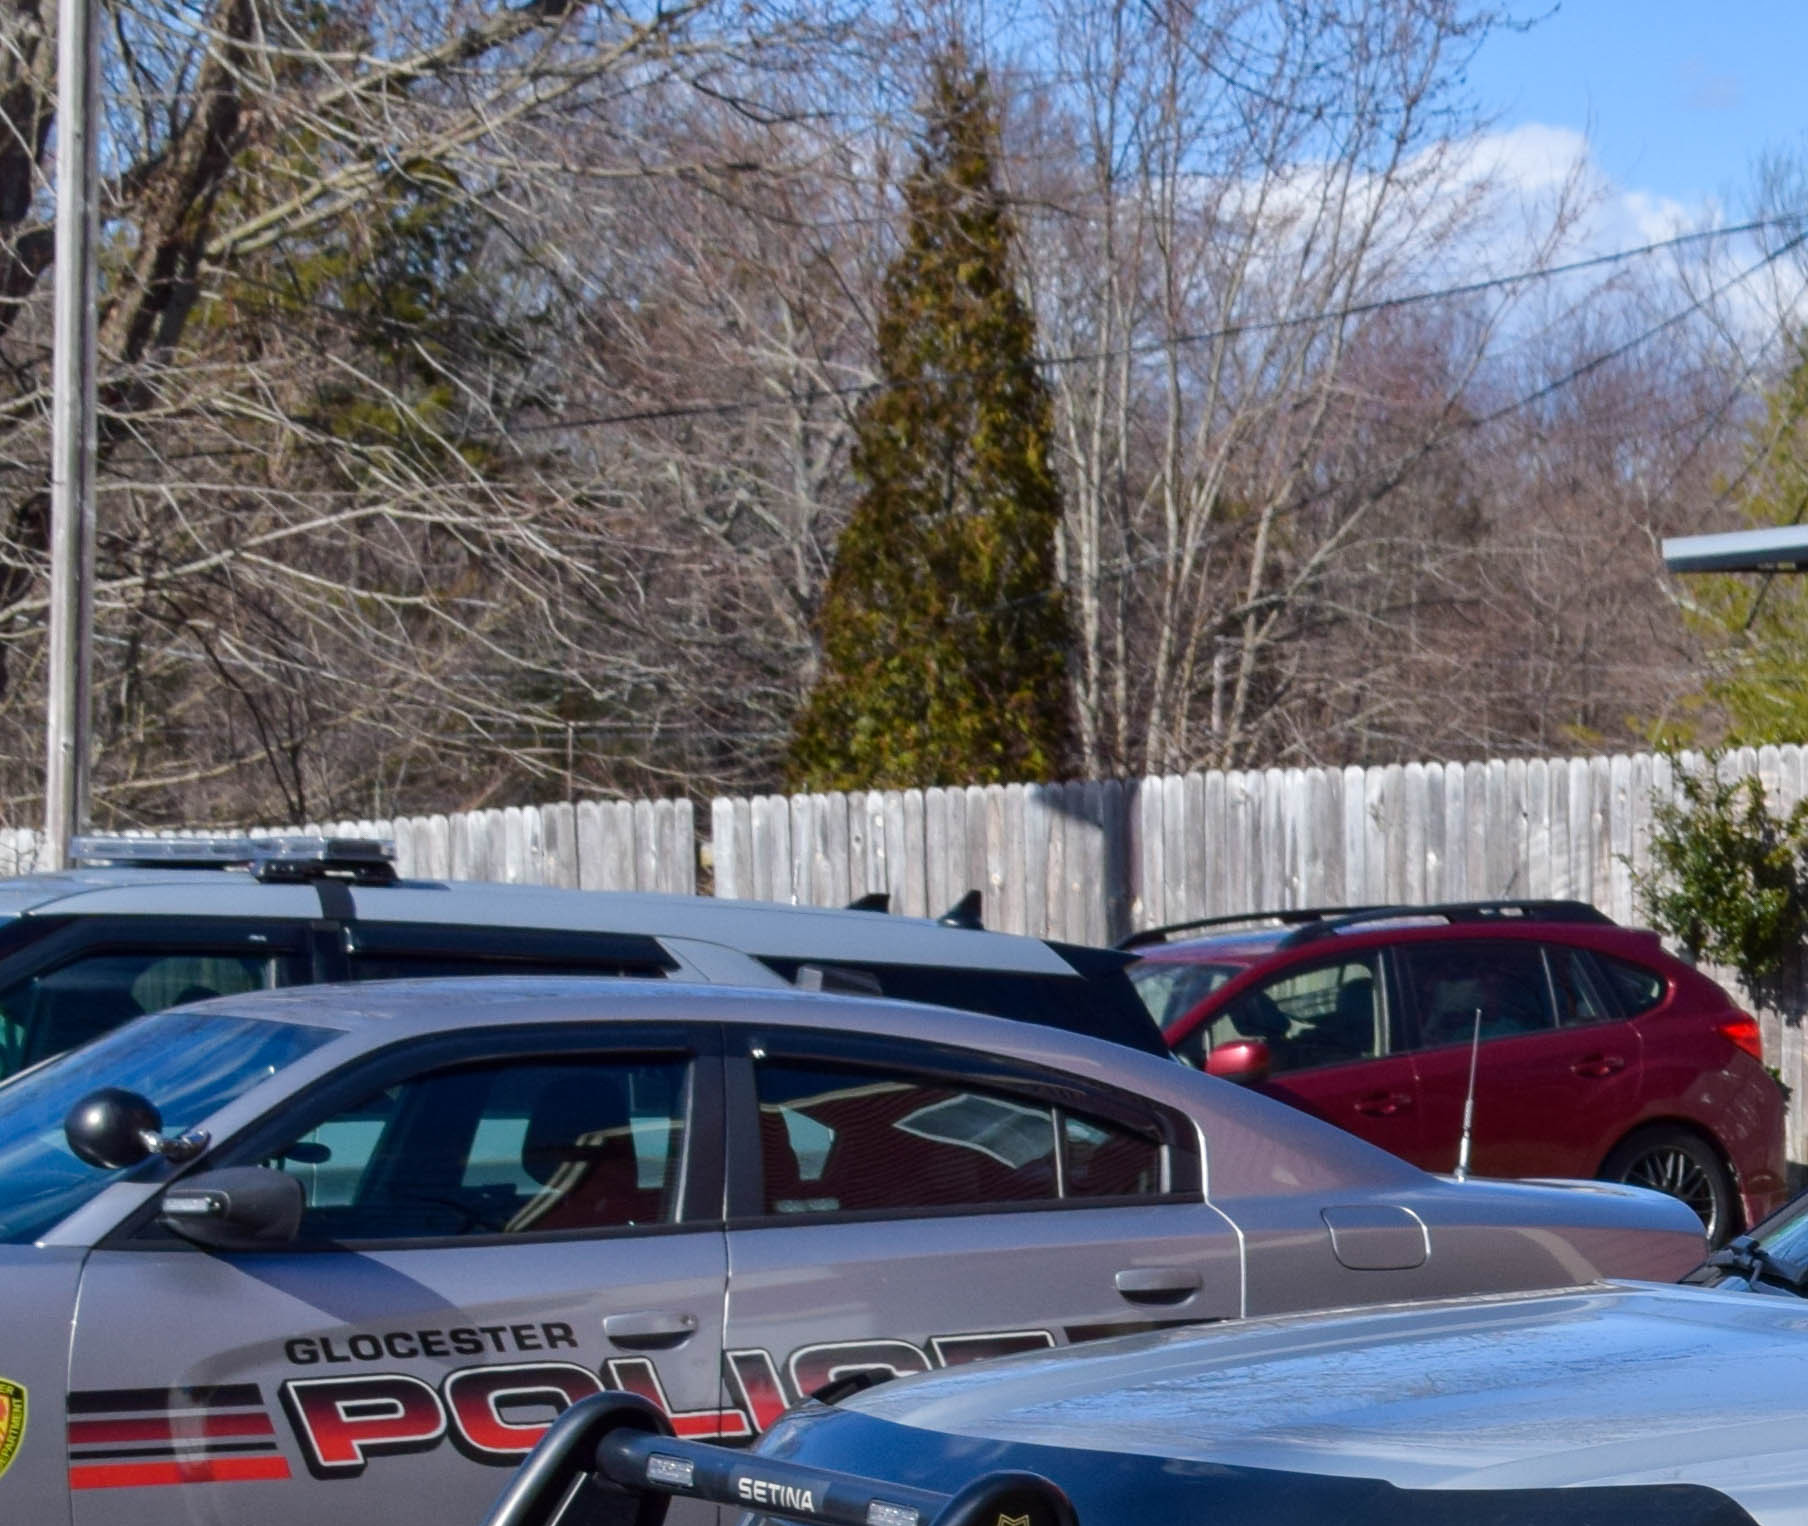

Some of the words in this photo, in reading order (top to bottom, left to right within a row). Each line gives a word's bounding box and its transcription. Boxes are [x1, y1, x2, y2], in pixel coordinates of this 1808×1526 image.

[283, 1321, 579, 1366] GLOCESTER
[0, 1398, 22, 1470] EPARTMENT
[737, 1476, 816, 1514] SETINA
